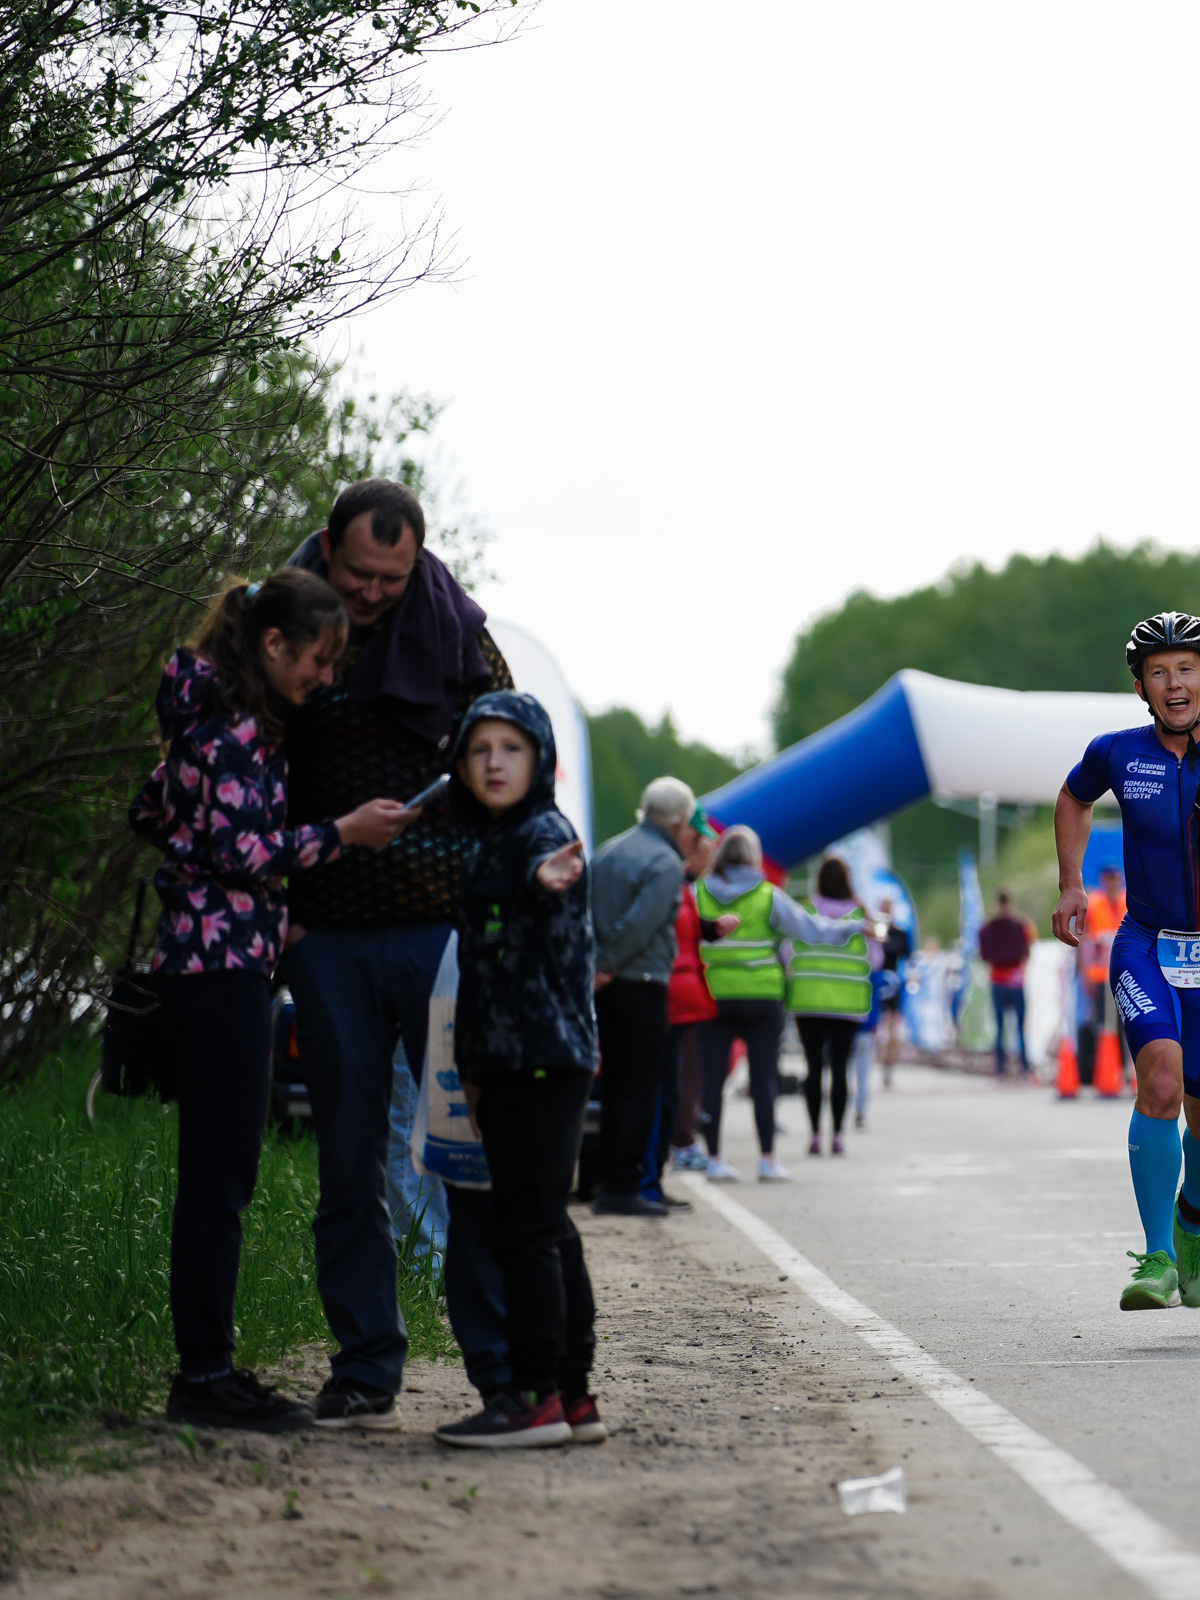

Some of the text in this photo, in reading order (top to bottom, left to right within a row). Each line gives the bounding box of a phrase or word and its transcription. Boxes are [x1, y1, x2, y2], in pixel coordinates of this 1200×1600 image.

[1123, 780, 1164, 790] КОМАНДА
[1123, 787, 1161, 795] ГАЗПРОМ
[1115, 982, 1140, 1022] ГАЗПРОМ
[1119, 970, 1157, 1014] КОМАНДА
